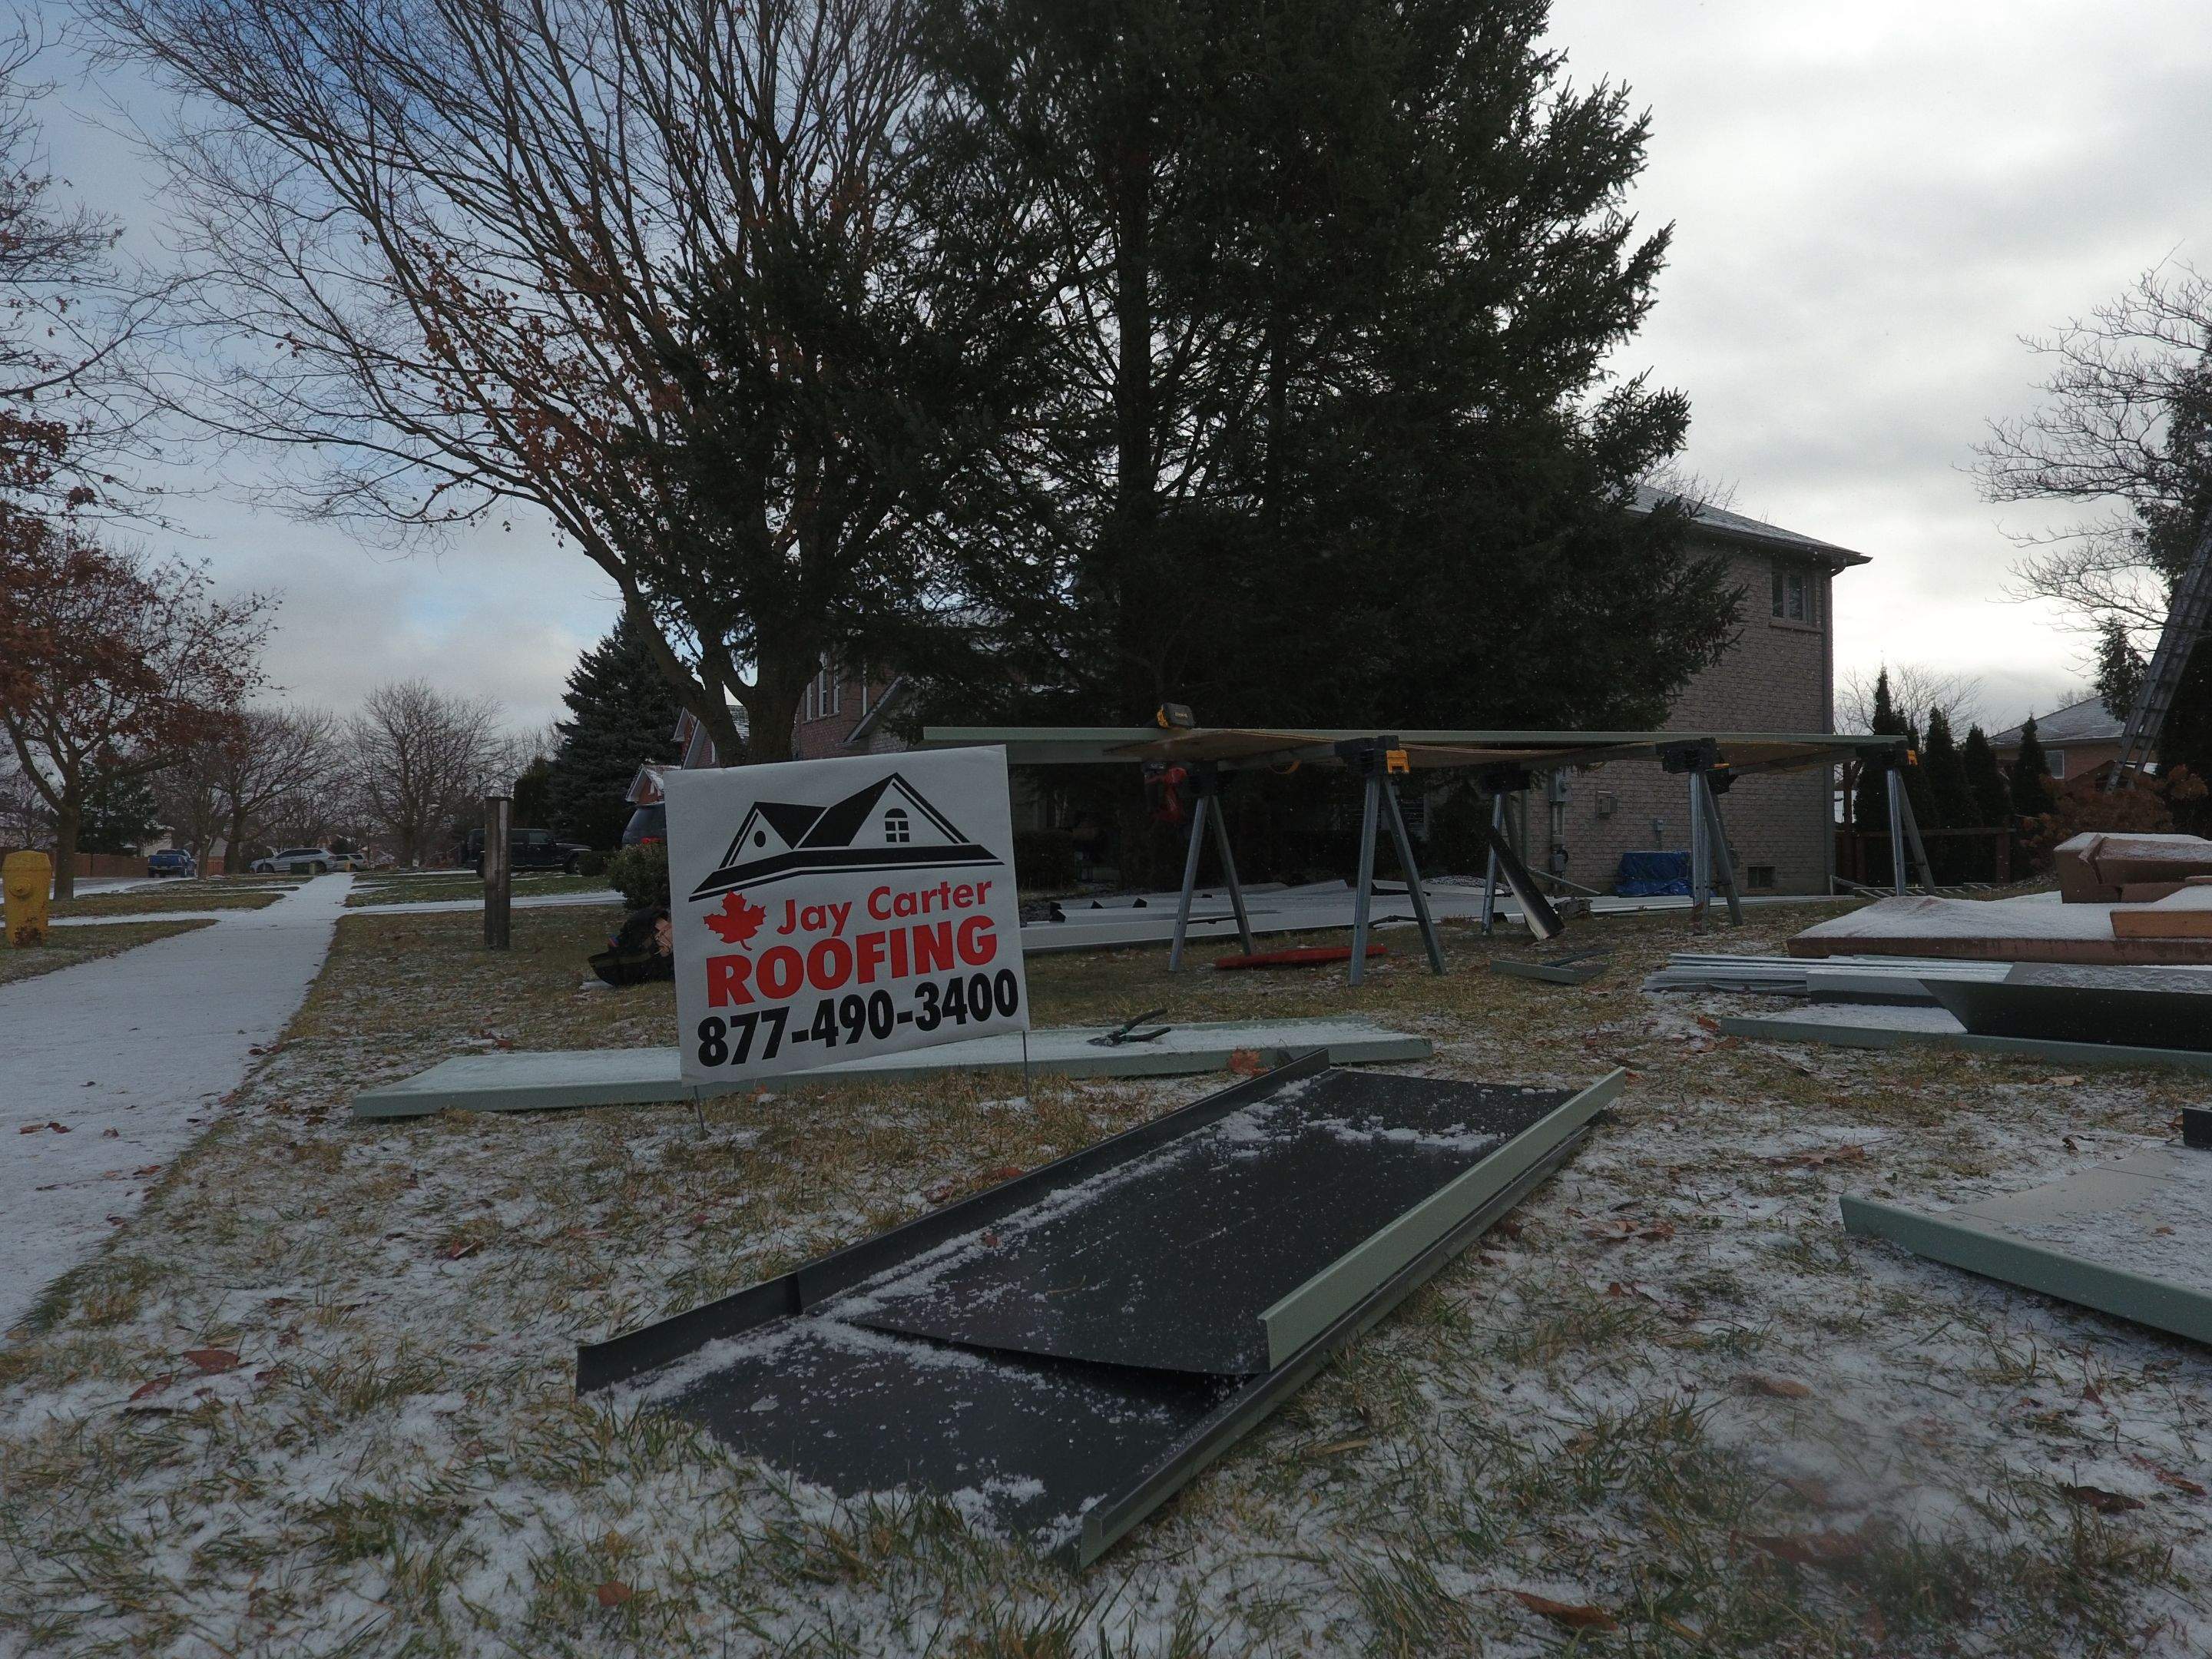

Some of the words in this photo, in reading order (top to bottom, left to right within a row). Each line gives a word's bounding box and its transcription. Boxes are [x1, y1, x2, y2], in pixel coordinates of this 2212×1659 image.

[777, 899, 852, 937] Jay
[867, 880, 992, 921] Carter
[706, 915, 998, 1008] ROOFING
[697, 968, 1018, 1068] 877-490-3400
